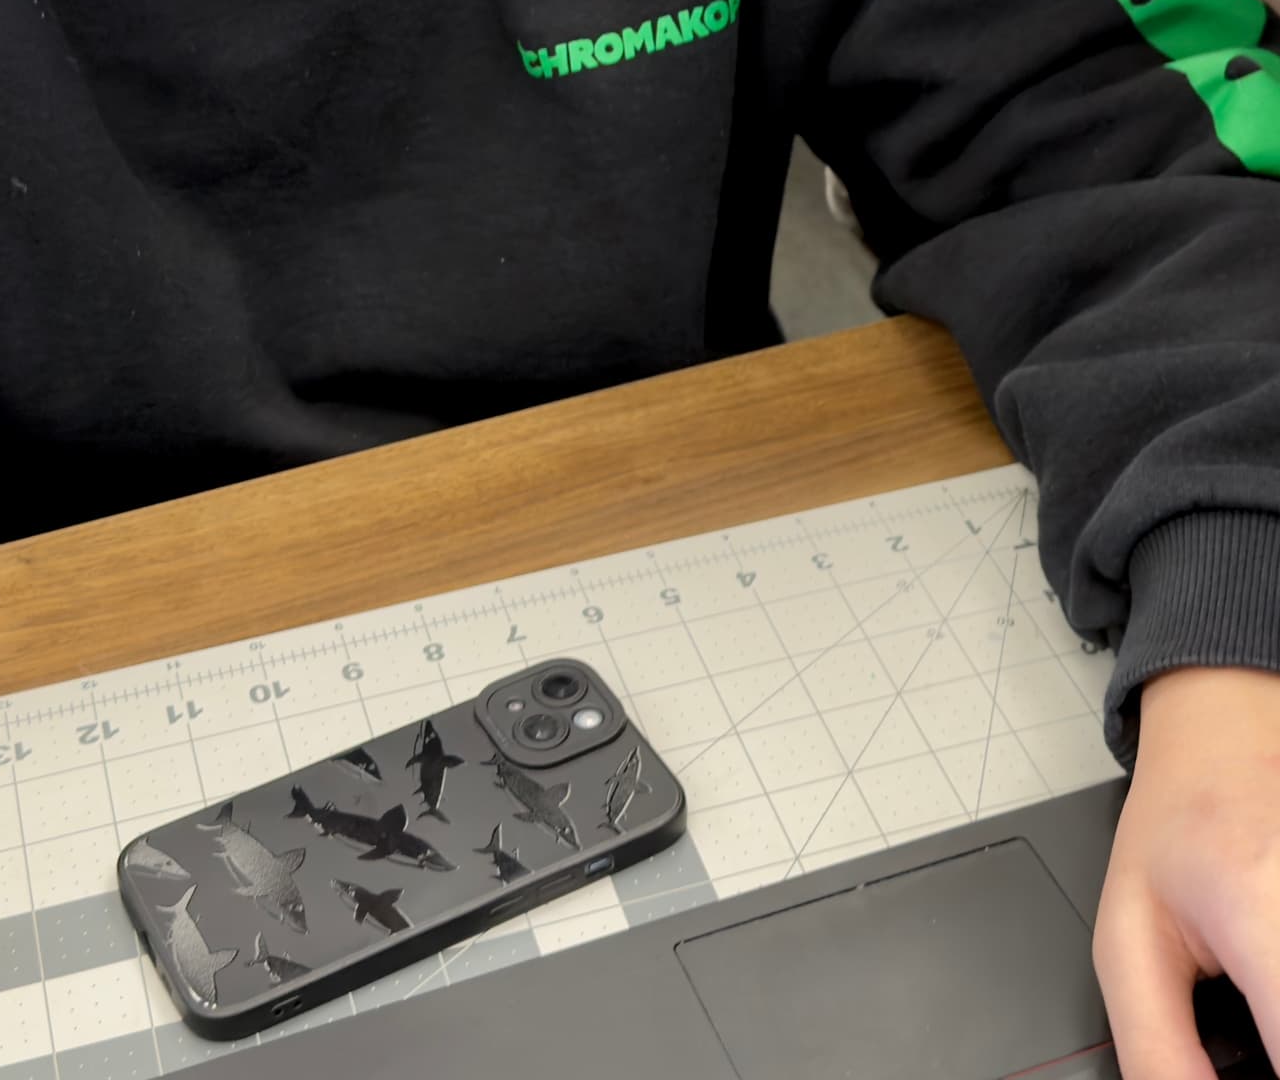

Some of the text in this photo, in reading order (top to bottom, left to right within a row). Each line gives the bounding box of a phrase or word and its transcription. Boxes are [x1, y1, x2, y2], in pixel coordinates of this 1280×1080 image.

[885, 535, 909, 553] 2
[811, 552, 833, 571] 3
[736, 571, 757, 588] 4
[660, 587, 681, 606] 5
[582, 605, 604, 624] 6
[506, 624, 528, 644] 7
[423, 642, 446, 662] 8
[342, 662, 364, 681] 9
[248, 680, 291, 704] 10
[166, 700, 204, 725] 11
[75, 720, 120, 745] 12
